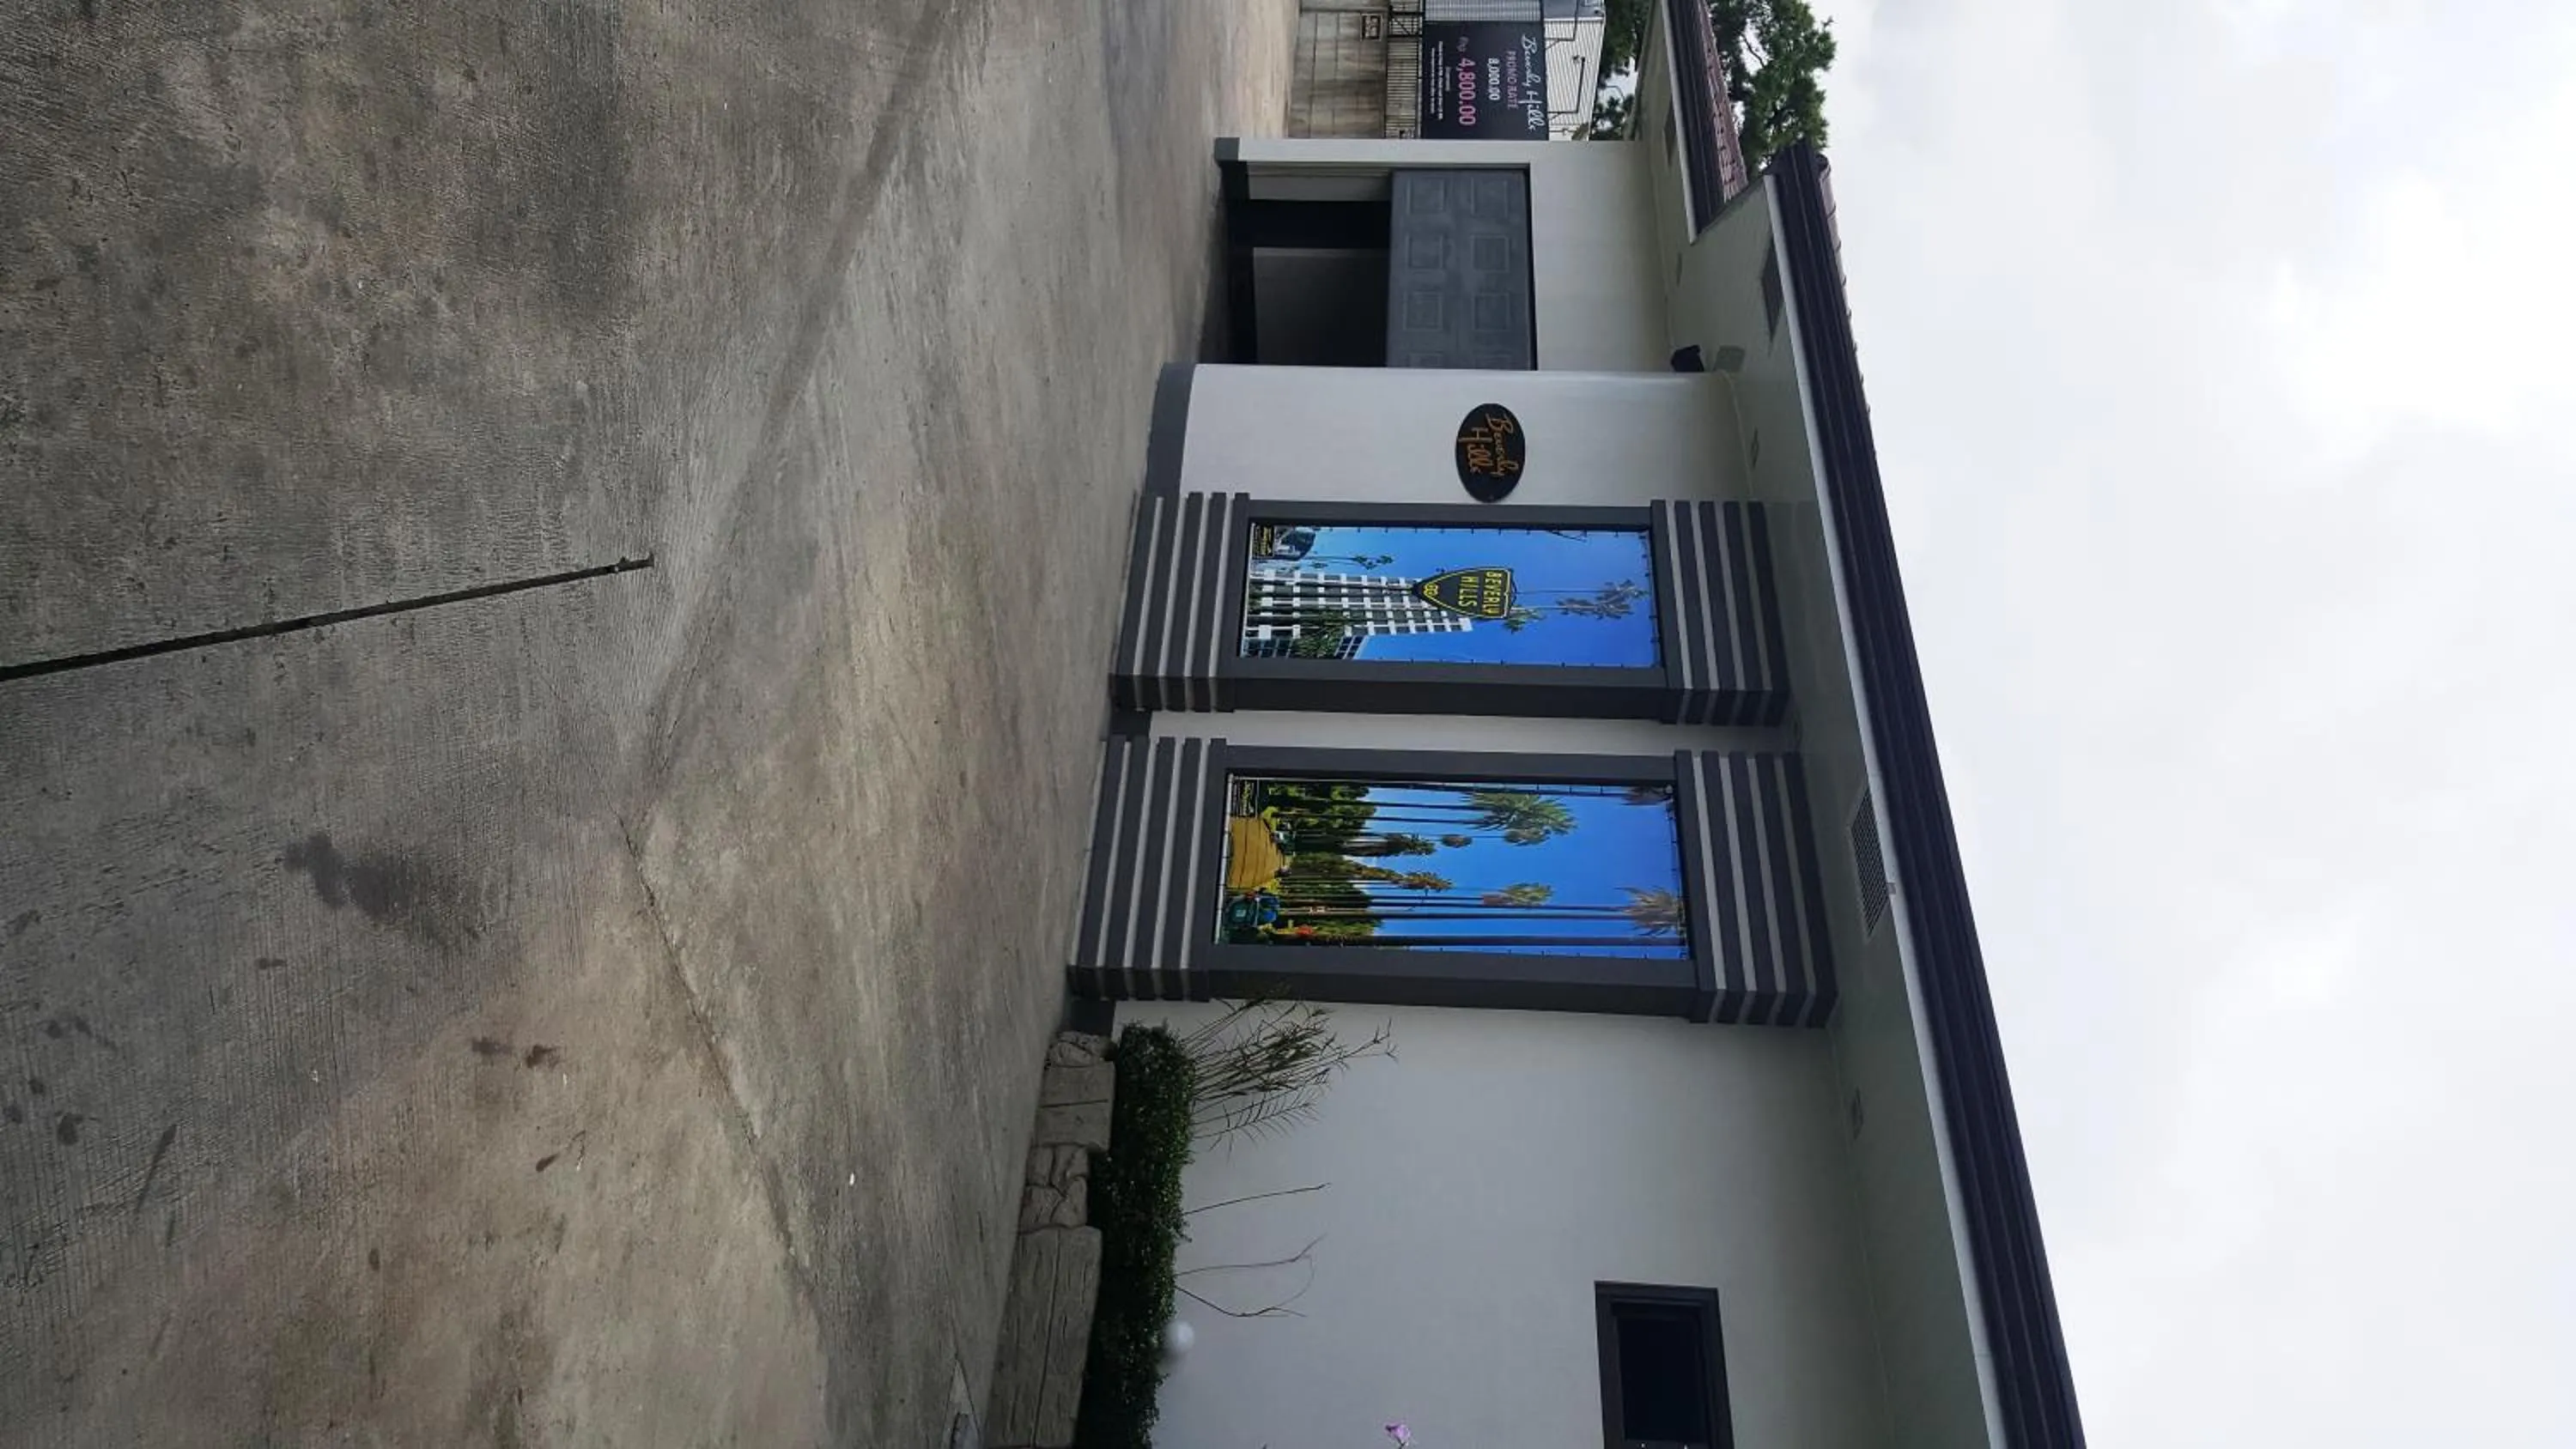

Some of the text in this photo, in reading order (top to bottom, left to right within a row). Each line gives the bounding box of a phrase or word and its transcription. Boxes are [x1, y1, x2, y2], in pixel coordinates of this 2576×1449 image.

[1456, 58, 1476, 125] 4,800.00
[1505, 50, 1519, 109] PROMO RATE
[1518, 90, 1546, 130] Hills
[1458, 427, 1494, 473] Hills
[1485, 413, 1519, 476] Beverly
[1458, 576, 1479, 607] HILLS
[1482, 571, 1503, 615] BEVERLY
